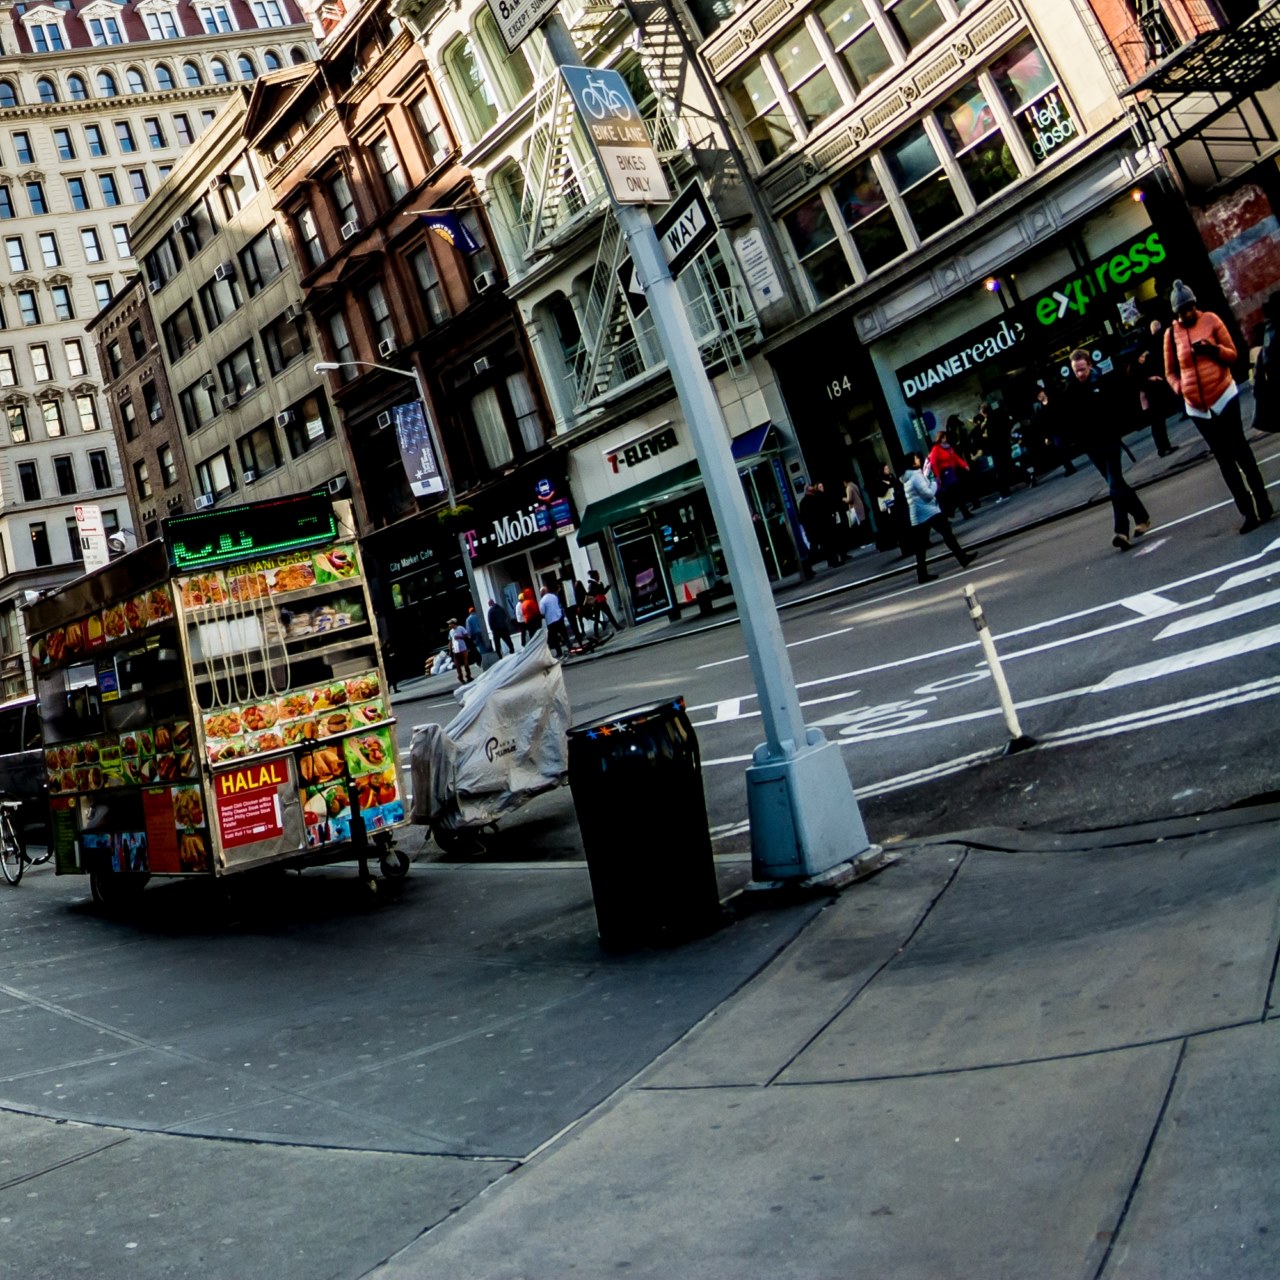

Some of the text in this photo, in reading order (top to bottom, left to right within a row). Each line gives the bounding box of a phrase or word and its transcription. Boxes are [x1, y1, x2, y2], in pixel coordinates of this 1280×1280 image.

[508, 9, 530, 38] EXCEPT
[1031, 92, 1060, 128] ted
[591, 124, 646, 142] BIKE LANE
[616, 155, 646, 171] BIKES
[625, 176, 652, 192] ONLY
[667, 208, 697, 253] WAY
[1035, 232, 1166, 325] express
[826, 375, 852, 400] 184
[390, 548, 434, 572] City Market Cafe
[221, 764, 282, 795] HALAL
